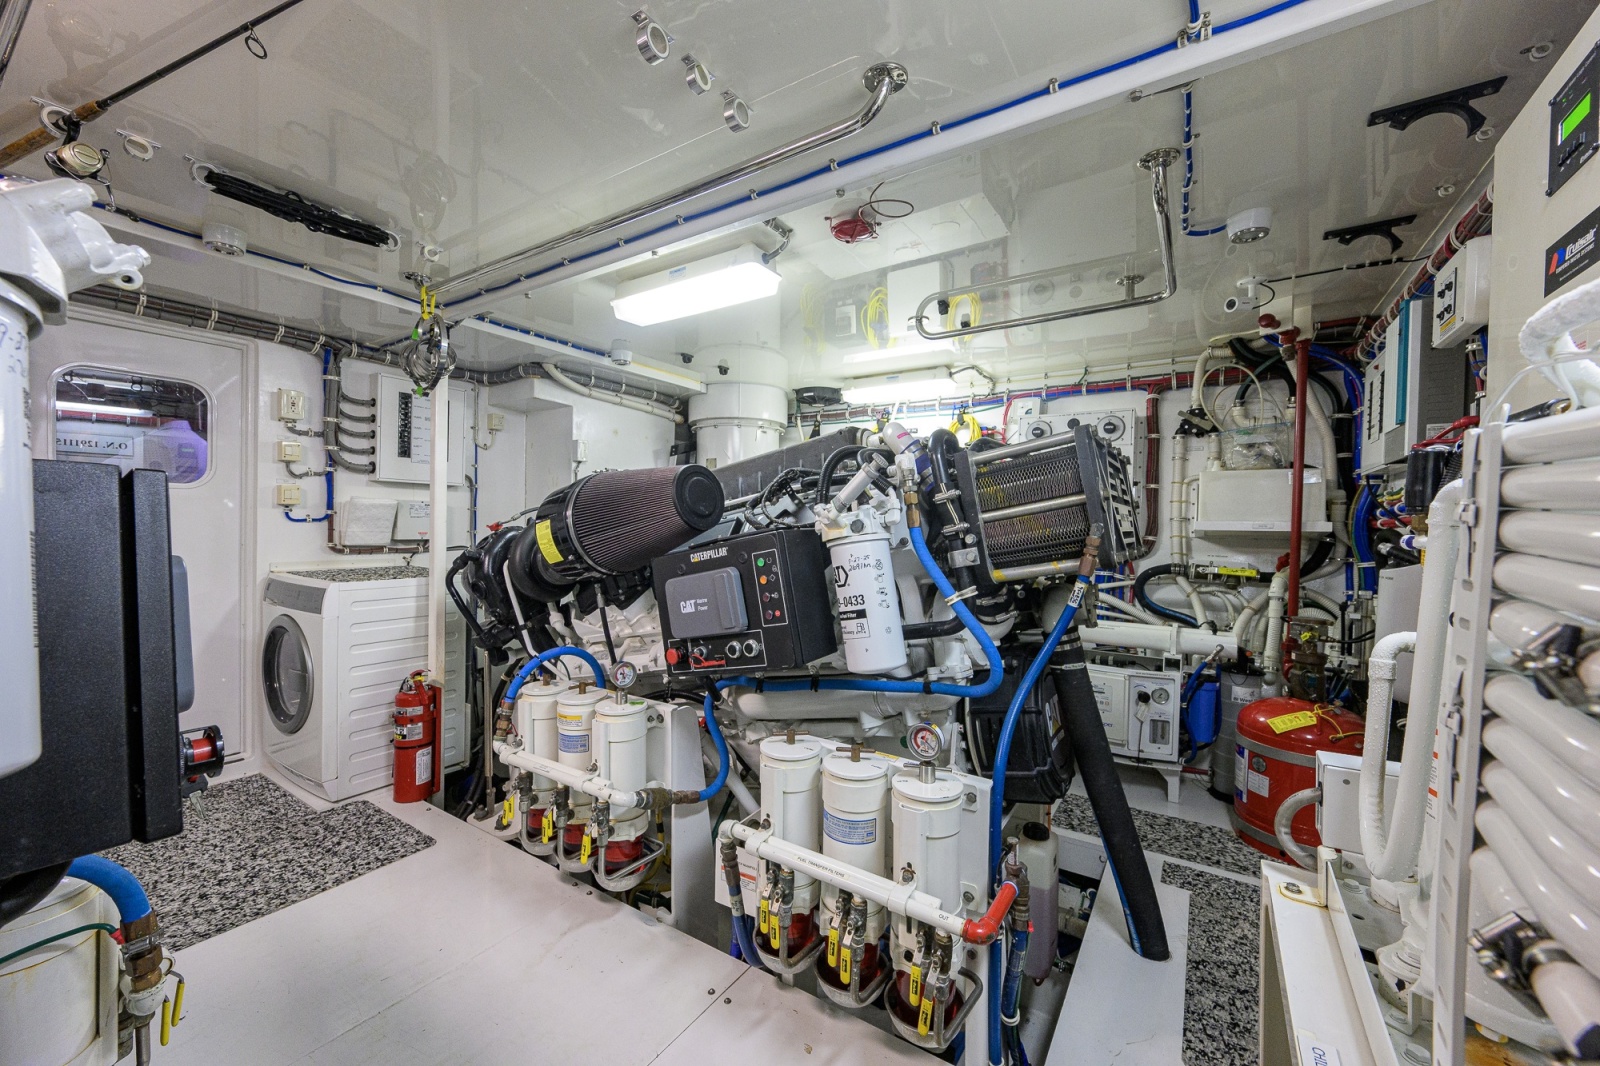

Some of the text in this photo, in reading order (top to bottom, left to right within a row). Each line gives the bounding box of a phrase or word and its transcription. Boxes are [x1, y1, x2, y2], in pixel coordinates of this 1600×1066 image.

[690, 547, 728, 563] CATERPILLAR
[680, 599, 696, 614] CAT
[797, 856, 807, 864] FUEL
[938, 913, 949, 921] OUT
